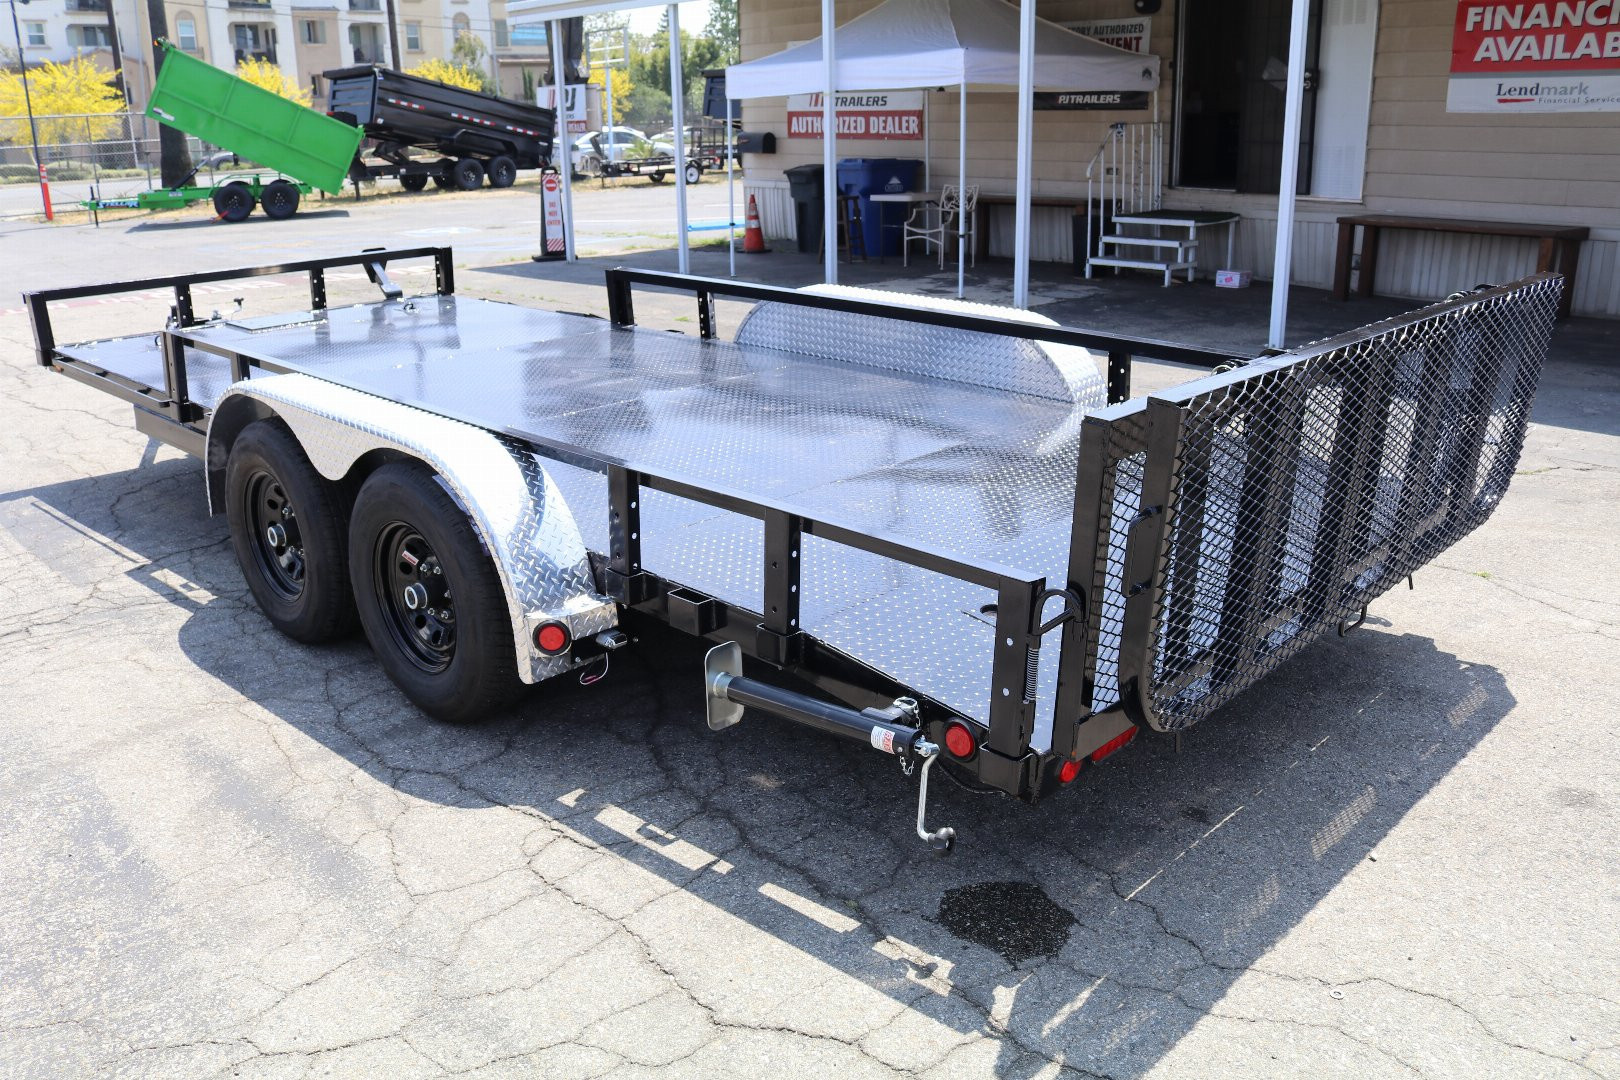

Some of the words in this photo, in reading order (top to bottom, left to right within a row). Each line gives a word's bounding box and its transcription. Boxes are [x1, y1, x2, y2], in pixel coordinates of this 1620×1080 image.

[1093, 24, 1144, 36] AUTHORIZED
[1099, 36, 1142, 53] VENT
[1473, 31, 1620, 62] AVAILAB
[1496, 82, 1590, 97] Lendmark
[835, 95, 888, 107] TRAILERS
[1070, 94, 1121, 104] TRAILERS
[1538, 96, 1581, 104] Financial
[791, 116, 866, 134] AUTHIZED
[869, 116, 919, 134] DEALER
